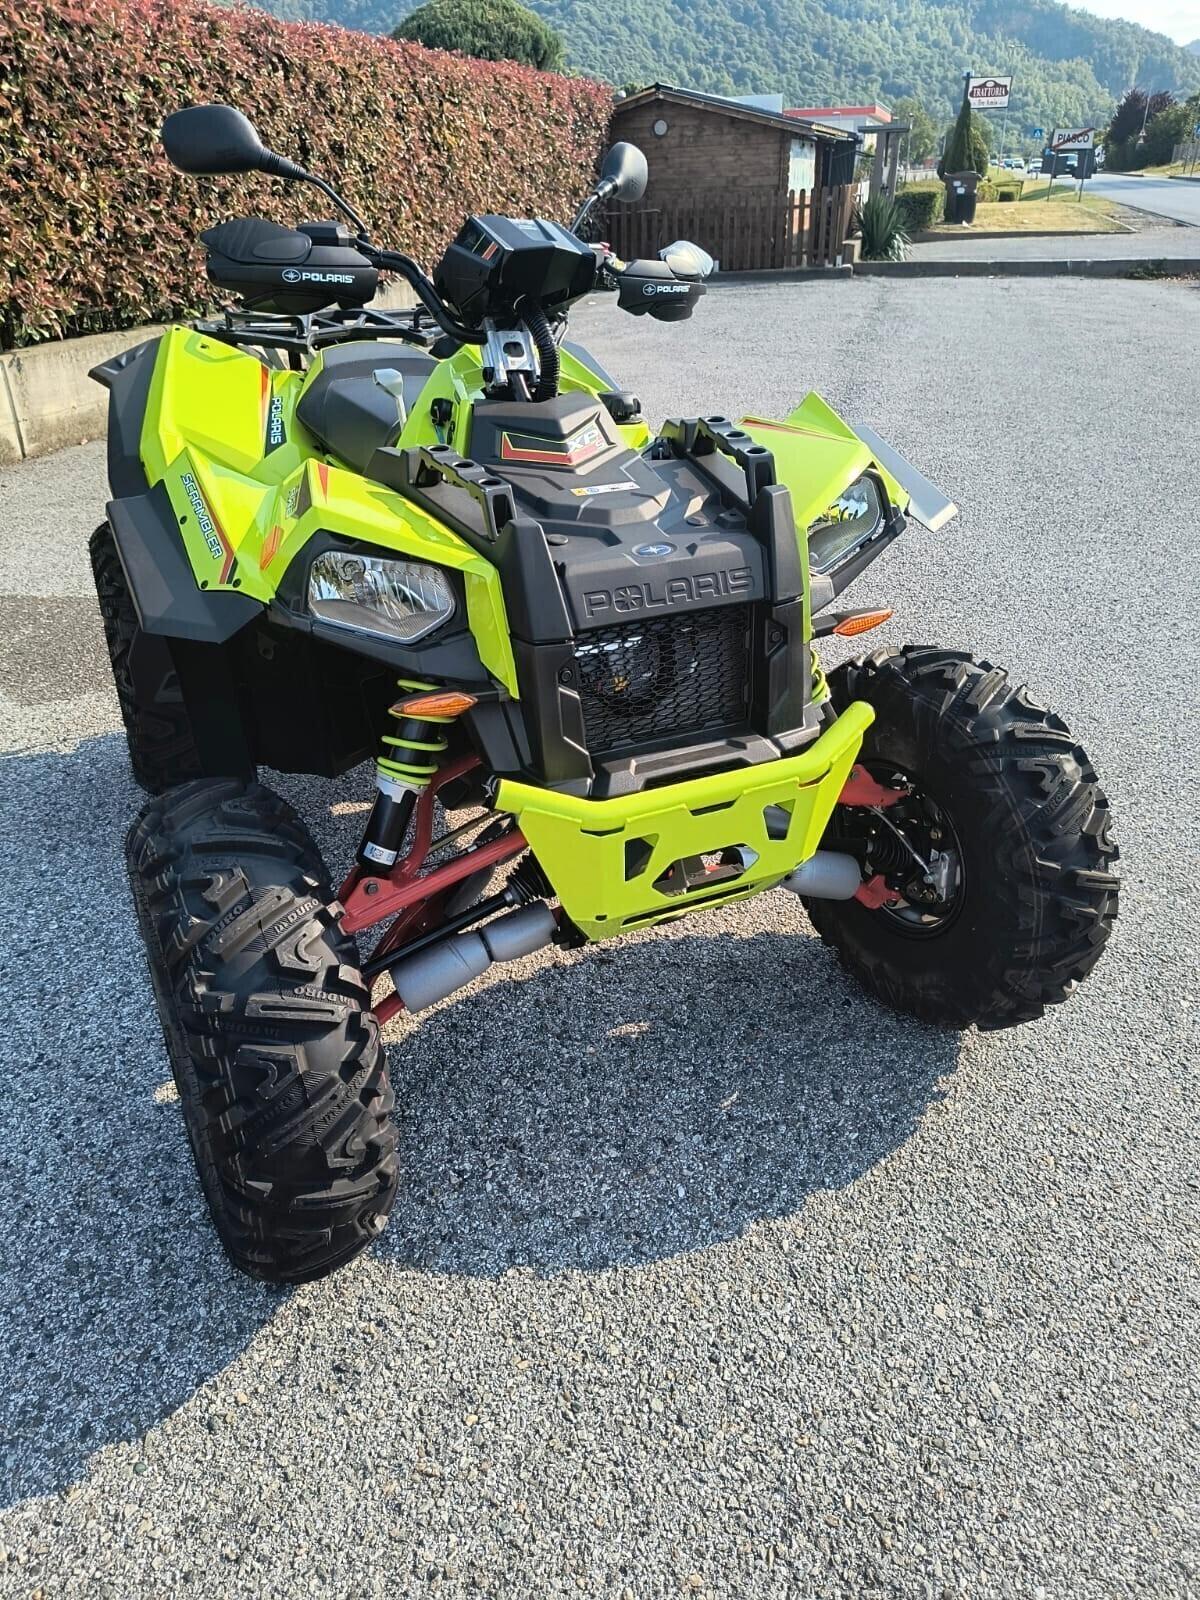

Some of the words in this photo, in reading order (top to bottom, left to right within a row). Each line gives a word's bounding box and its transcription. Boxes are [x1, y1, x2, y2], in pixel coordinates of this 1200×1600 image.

[973, 86, 1006, 97] TRATTORIA
[1057, 133, 1089, 143] PIASCO
[302, 272, 354, 284] POLARIS
[657, 285, 689, 293] POLARIS
[270, 396, 282, 445] POLARIS
[569, 428, 599, 450] XP
[181, 473, 223, 559] SCRAMBLER
[582, 566, 752, 619] POLARIS
